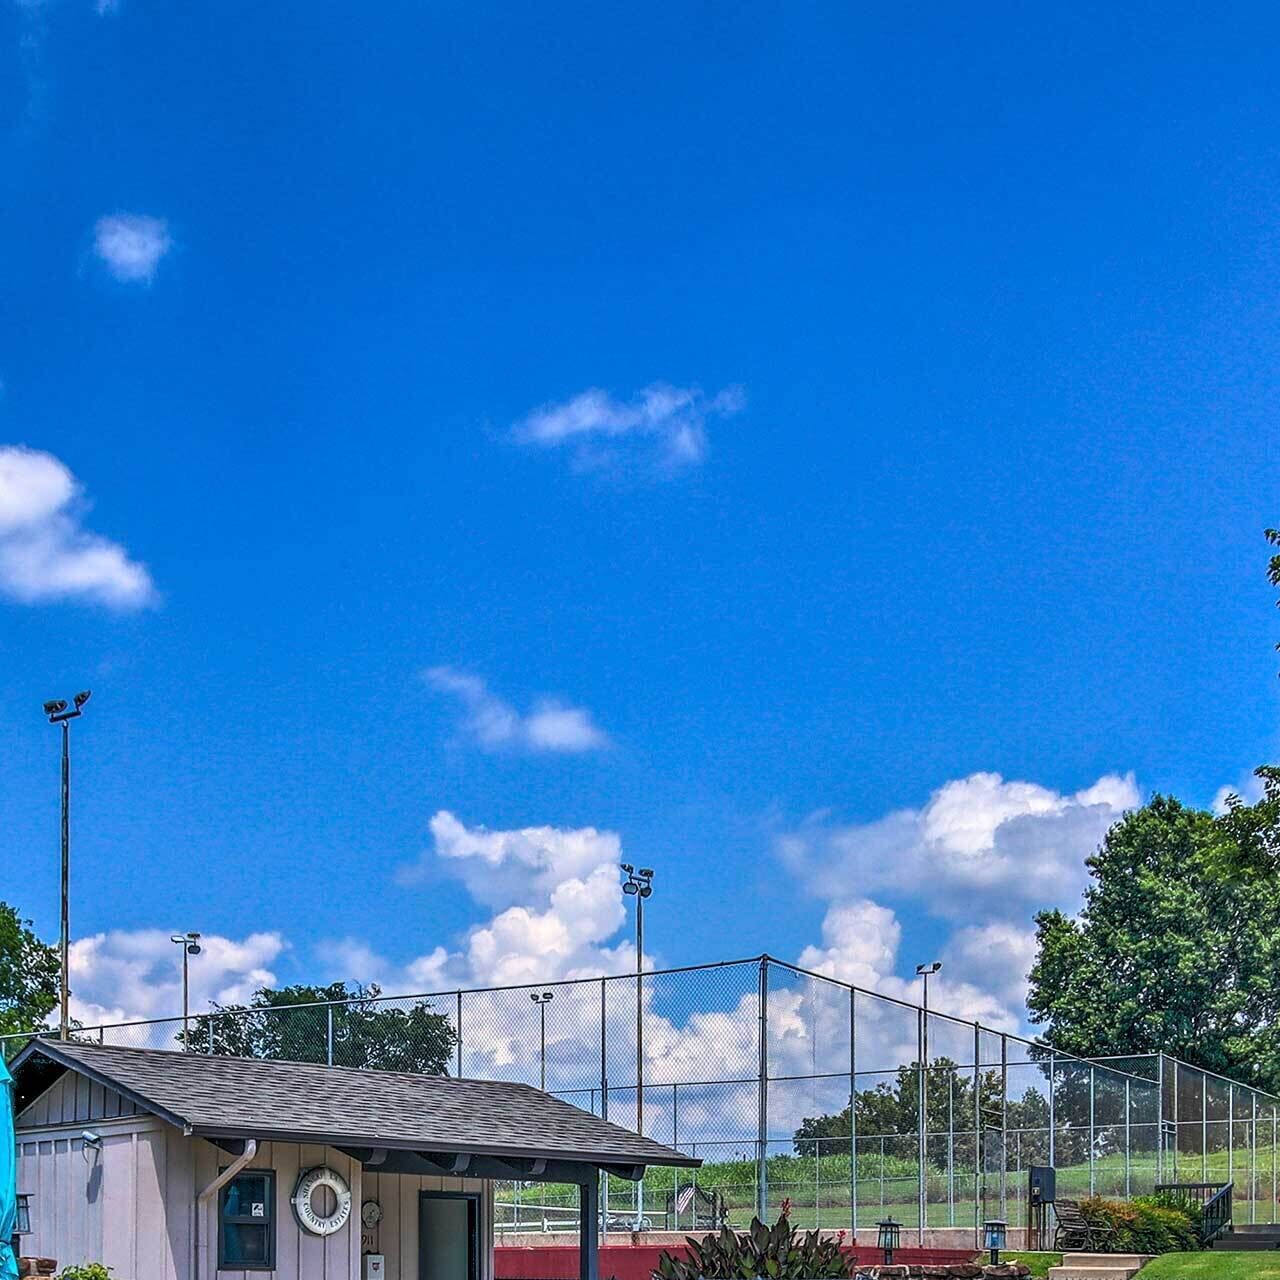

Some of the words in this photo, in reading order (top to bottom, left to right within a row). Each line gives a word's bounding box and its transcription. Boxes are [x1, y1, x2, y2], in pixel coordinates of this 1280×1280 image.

[303, 1202, 325, 1228] COUNTRY
[329, 1201, 349, 1228] ESTATES
[361, 1234, 374, 1246] 911
